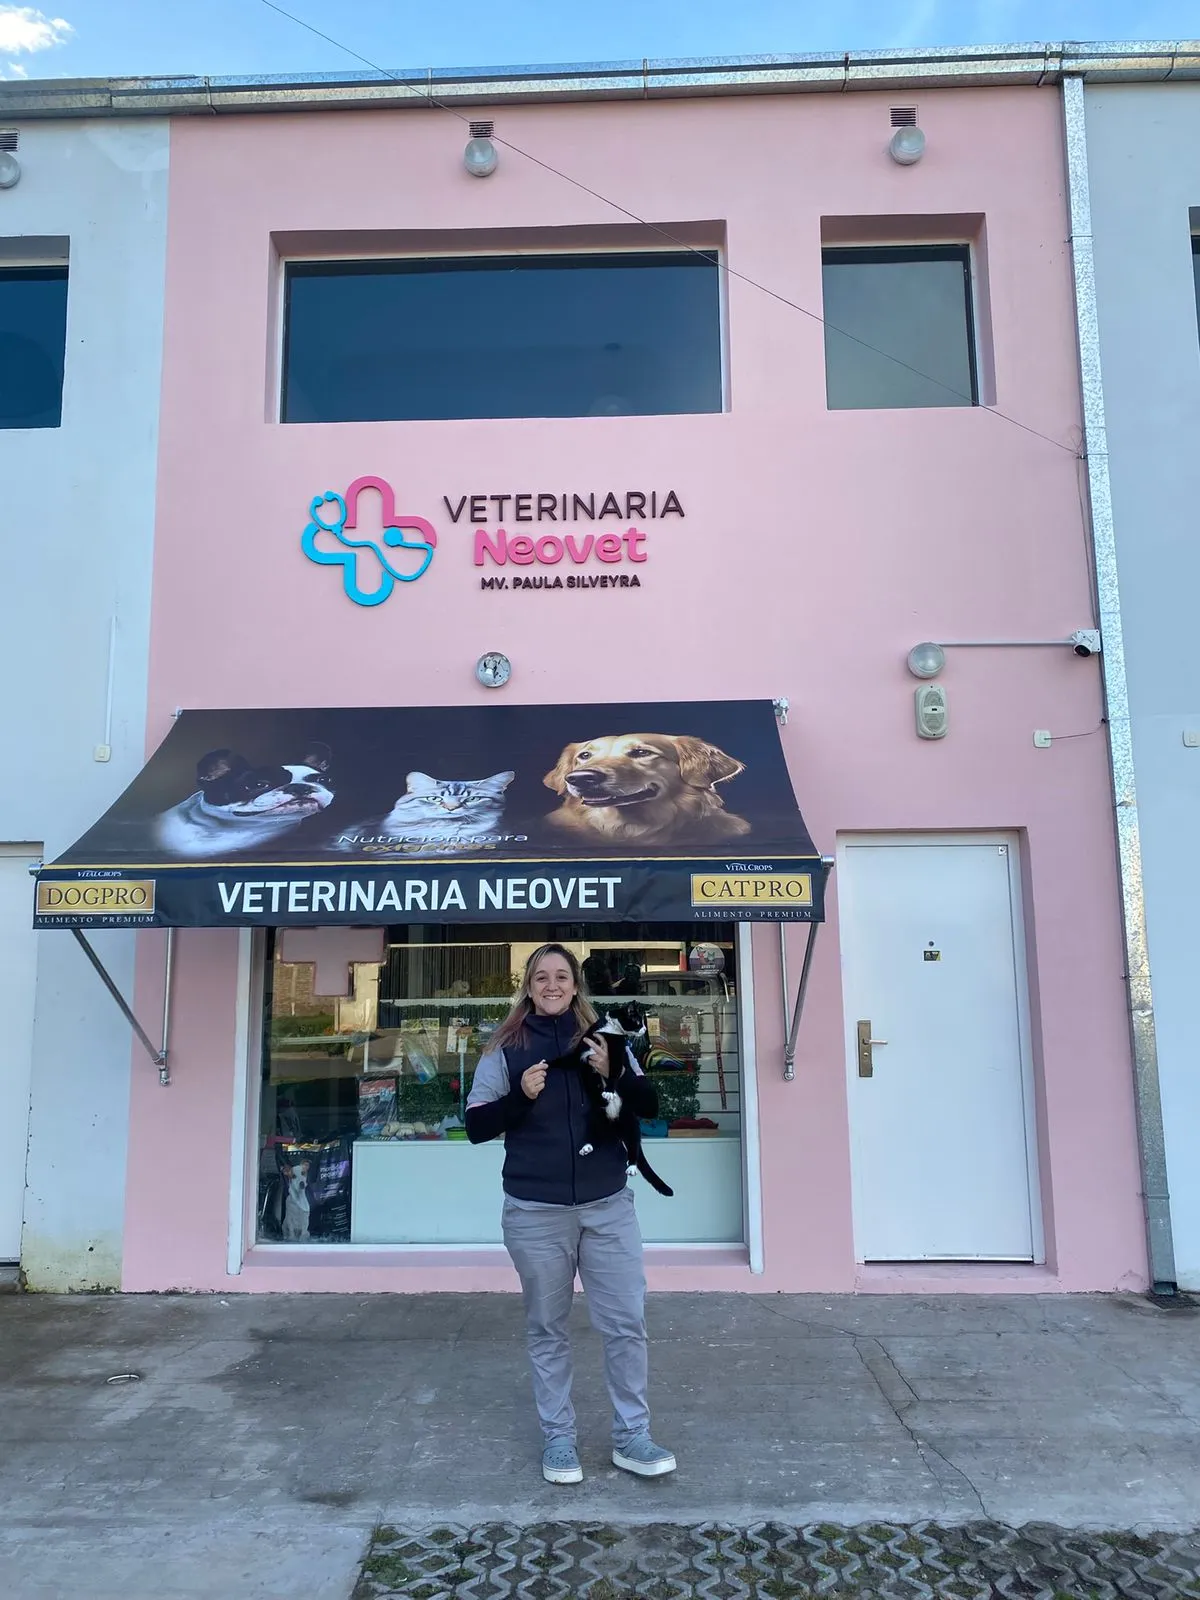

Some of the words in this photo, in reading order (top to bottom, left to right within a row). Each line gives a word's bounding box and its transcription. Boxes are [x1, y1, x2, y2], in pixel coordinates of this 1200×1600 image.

[443, 490, 685, 523] VETERINARIA
[473, 527, 648, 566] Neovet
[481, 577, 509, 590] MV.
[513, 576, 563, 589] PAULA
[566, 574, 641, 589] SILVEYRA
[470, 834, 528, 843] para
[46, 887, 147, 905] DOGPRO
[218, 880, 467, 913] VETERINARIA
[478, 877, 622, 910] NEOVET
[701, 881, 802, 897] CATPRO
[36, 916, 93, 924] ALIMENTO
[102, 915, 154, 923] PREMIUM
